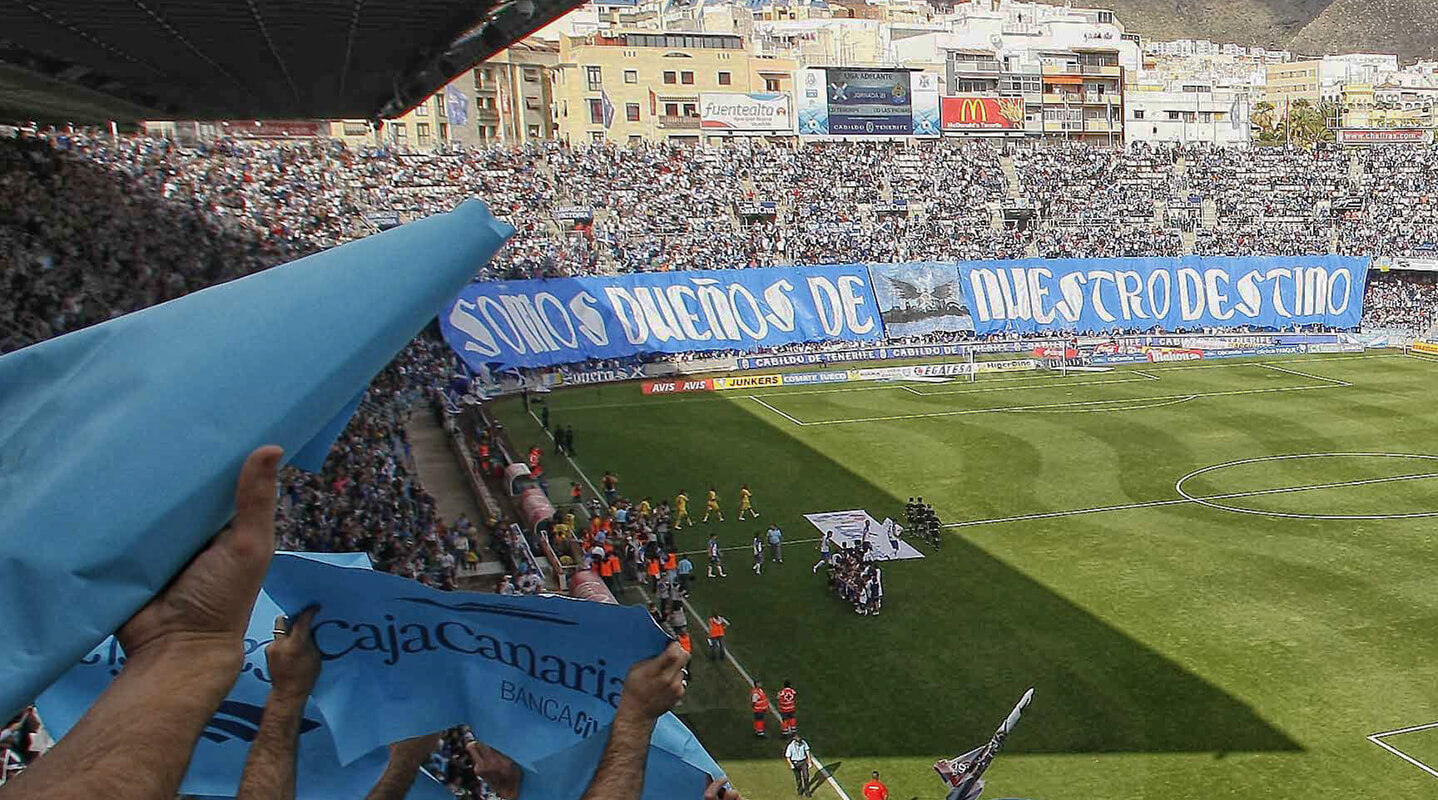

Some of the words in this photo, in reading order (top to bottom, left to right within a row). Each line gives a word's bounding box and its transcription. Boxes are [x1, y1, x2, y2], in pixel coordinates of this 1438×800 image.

[702, 102, 774, 118] fuentealta
[970, 266, 1171, 325] NUESTRO
[1178, 267, 1351, 321] DESTINO
[449, 289, 608, 356] SOMOS
[604, 278, 796, 345] DUEÑOS
[807, 275, 876, 336] DE
[756, 355, 804, 367] CABILDO
[809, 354, 822, 362] DE
[826, 350, 876, 362] TENERIFE
[893, 347, 941, 357] CABILDO
[944, 346, 957, 354] DE
[652, 383, 675, 392] AVIS
[683, 381, 705, 391] AVIS
[729, 376, 779, 387] JUNKERS
[312, 614, 625, 709] CajaCanaria
